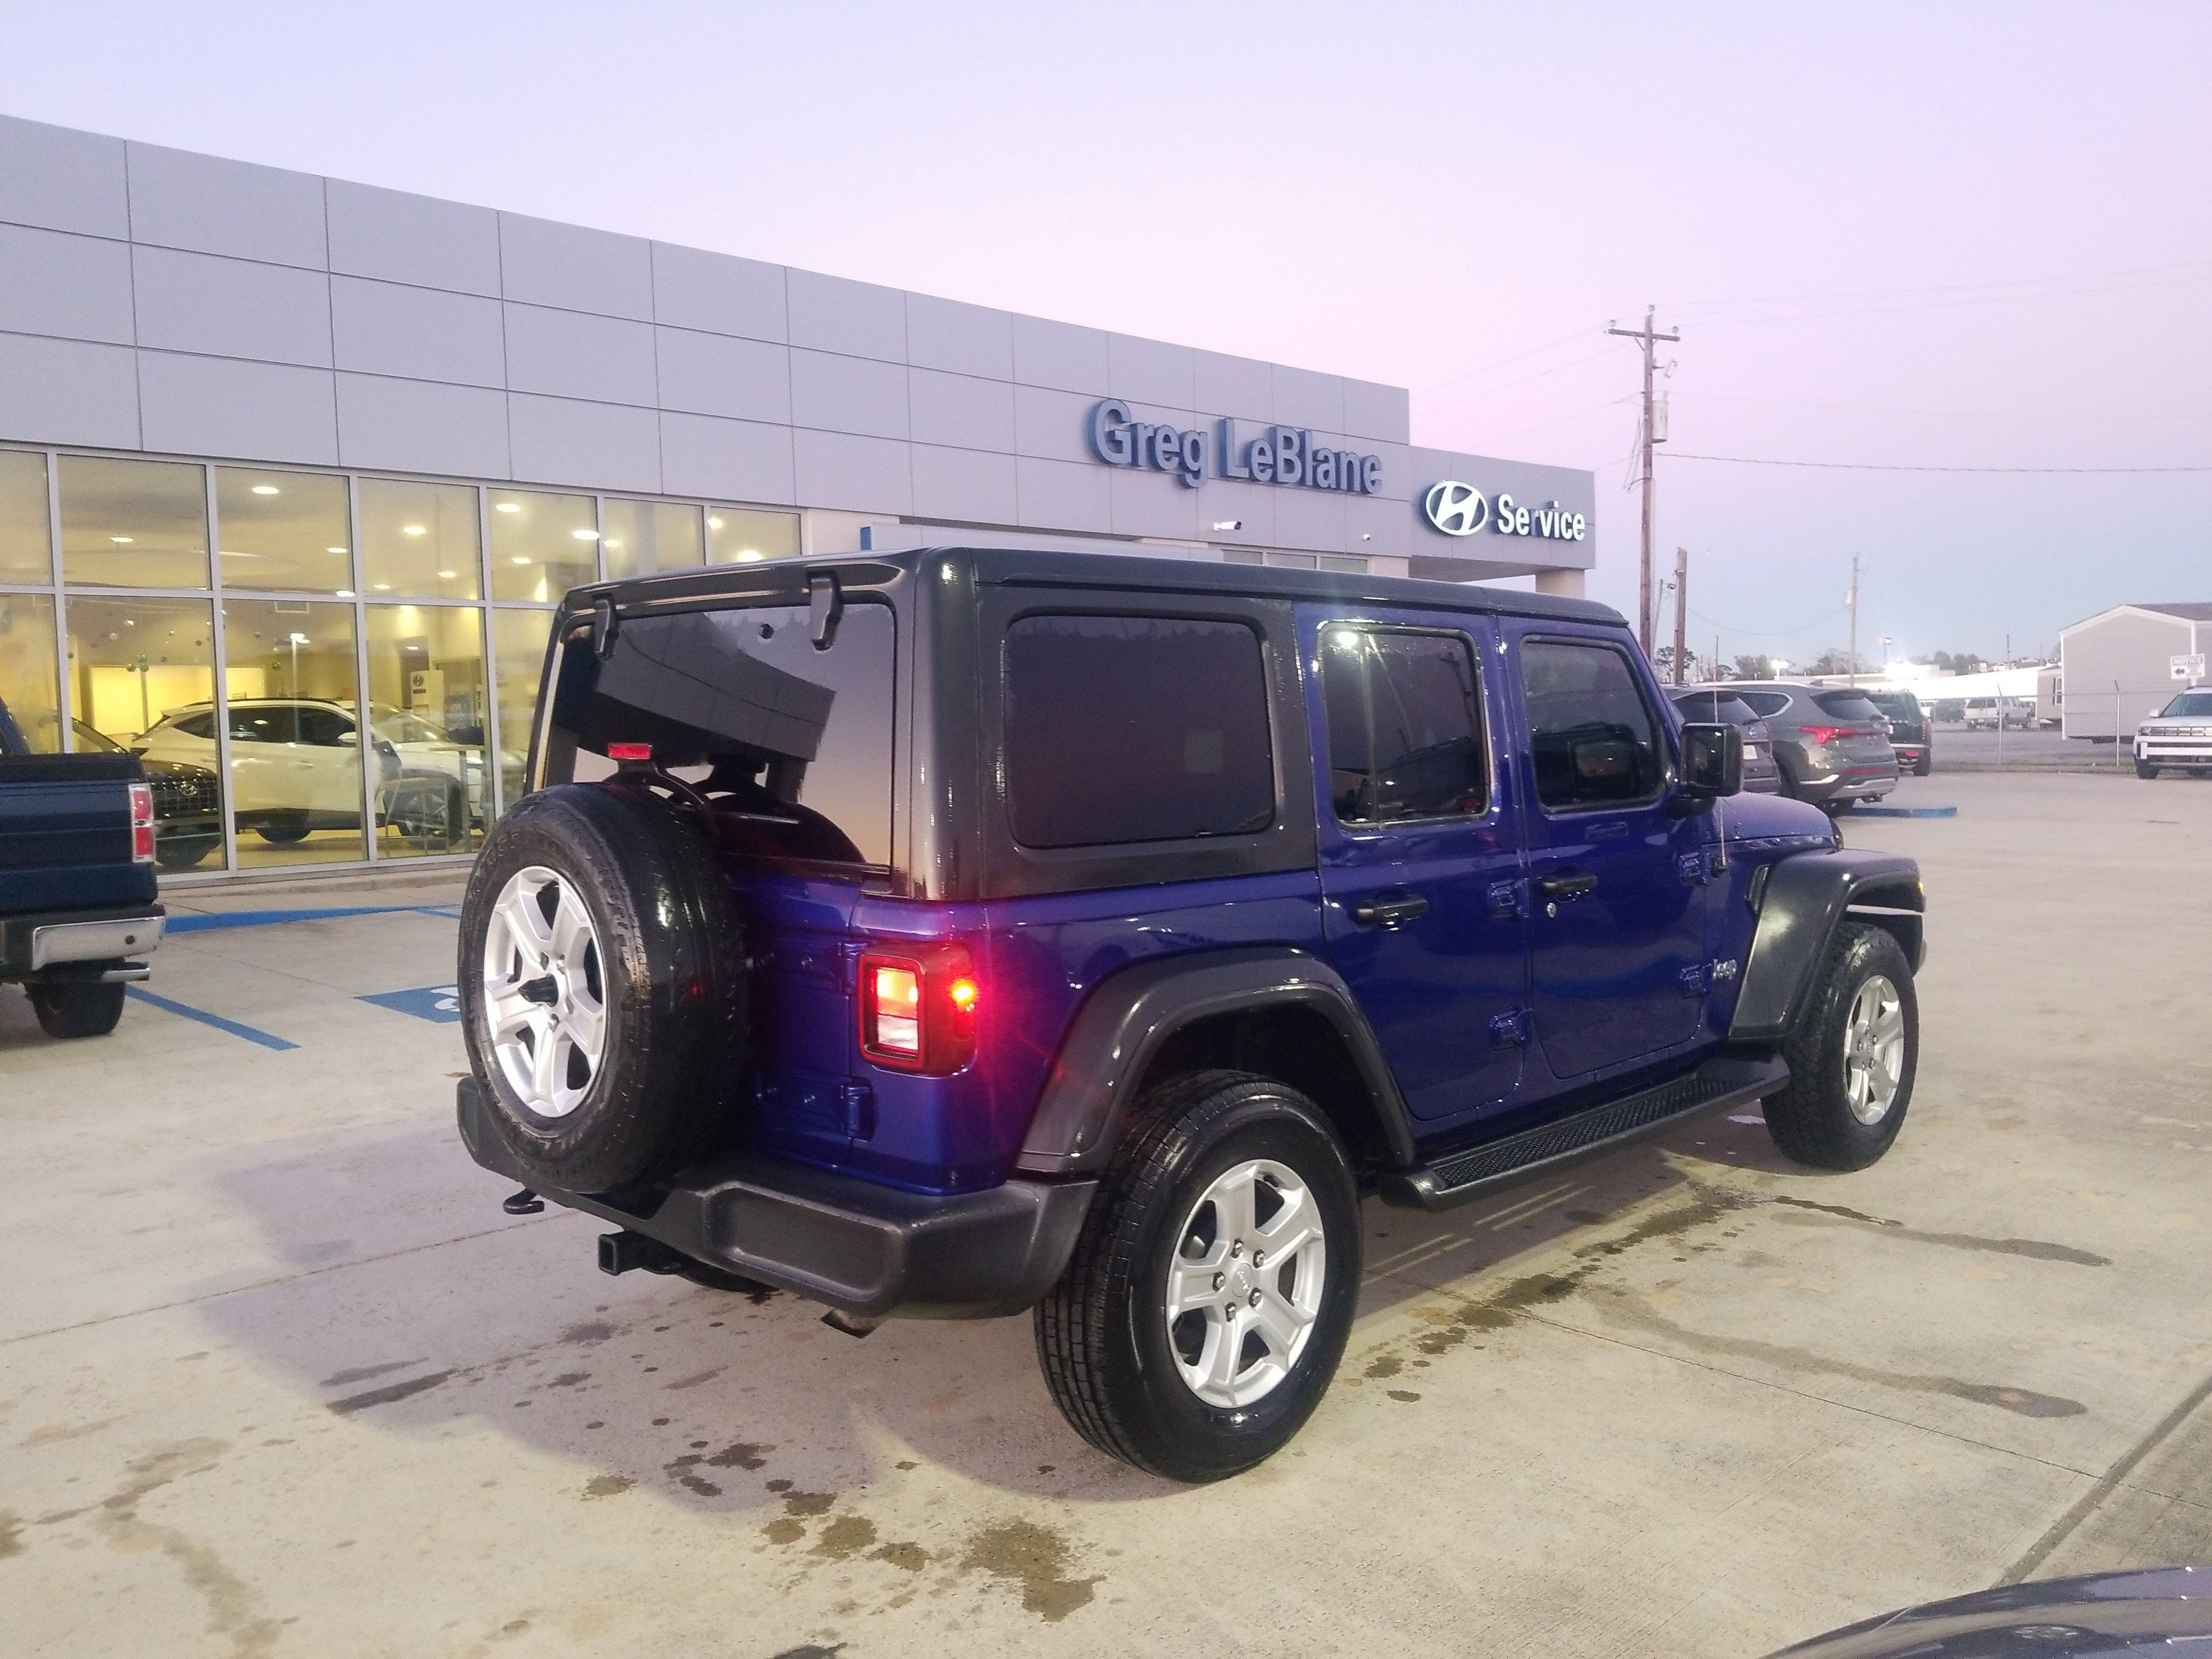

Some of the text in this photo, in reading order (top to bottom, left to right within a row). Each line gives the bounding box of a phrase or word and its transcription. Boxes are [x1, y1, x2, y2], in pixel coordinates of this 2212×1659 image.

[1089, 399, 1382, 494] Greg LeBlanc
[1497, 493, 1586, 541] Service
[1712, 958, 1737, 980] Jeep
